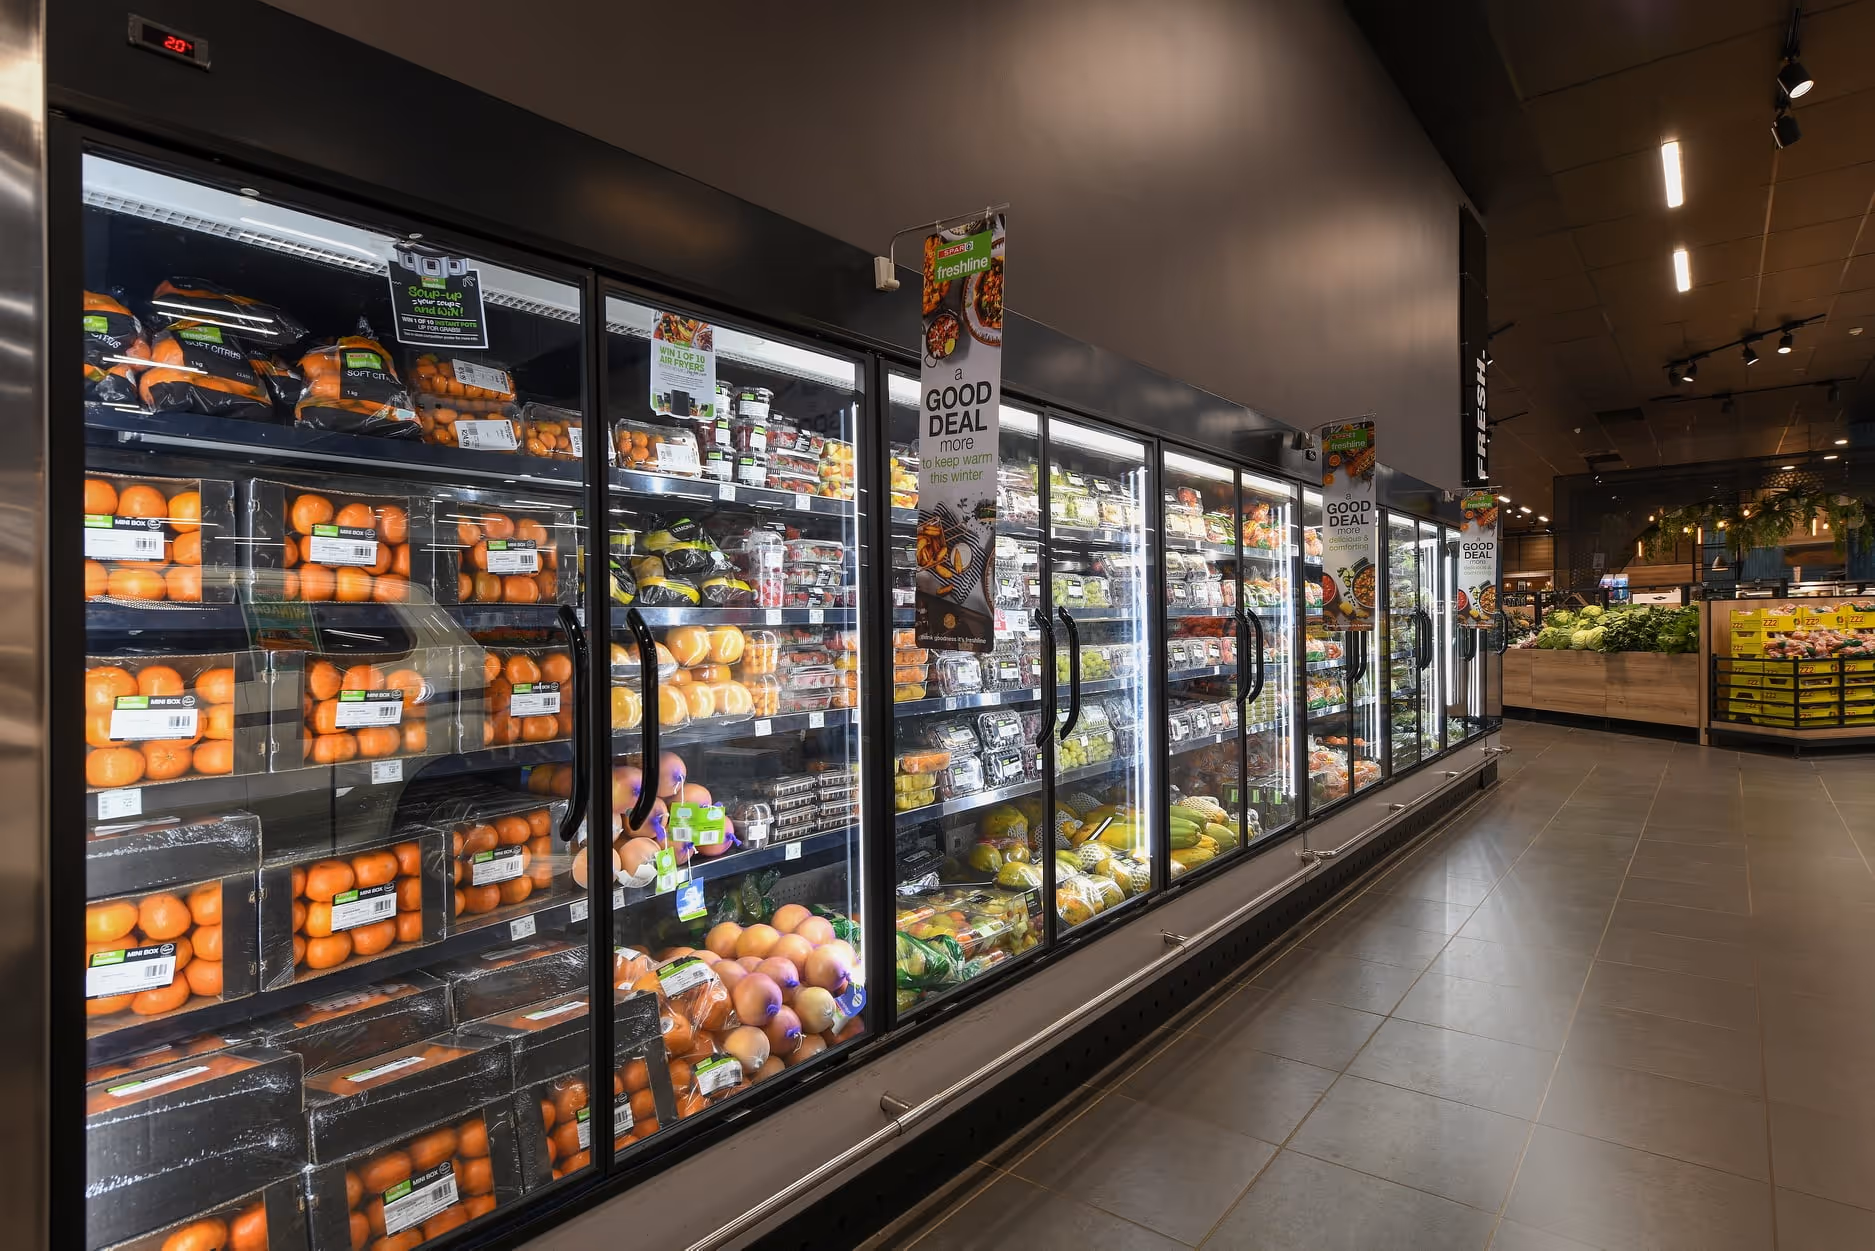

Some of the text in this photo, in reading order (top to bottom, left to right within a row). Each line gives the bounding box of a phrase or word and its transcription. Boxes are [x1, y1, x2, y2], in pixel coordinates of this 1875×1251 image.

[943, 243, 965, 257] SPAR
[937, 256, 988, 280] freshline
[408, 286, 462, 300] Soup-up
[414, 306, 436, 315] and
[211, 345, 241, 360] CITRUS
[659, 345, 675, 357] WIN
[683, 352, 694, 361] OF
[696, 354, 706, 363] 10
[660, 355, 673, 365] AIR
[674, 359, 705, 373] FRYERS
[347, 370, 370, 378] SOFT
[954, 368, 963, 381] a
[926, 381, 992, 412] GOOD
[929, 409, 988, 437] DEAL
[940, 437, 974, 453] more
[1331, 440, 1366, 450] freshline
[922, 453, 993, 470] to keep warm
[930, 469, 984, 484] this winter
[1327, 500, 1371, 515] GOOD
[131, 519, 146, 527] BOX
[1329, 514, 1369, 527] DEAL
[1337, 526, 1360, 535] more
[1329, 535, 1361, 544] delicious
[1328, 543, 1369, 551] comforting
[1463, 542, 1494, 551] GOOD
[1464, 551, 1492, 559] DEAL
[1763, 619, 1778, 627] ZZ2
[1806, 618, 1820, 626] ZZ2
[359, 886, 384, 897] MINI BOX
[127, 950, 143, 958] MINI
[143, 948, 160, 956] BOX
[412, 1169, 439, 1187] MINI BOX
